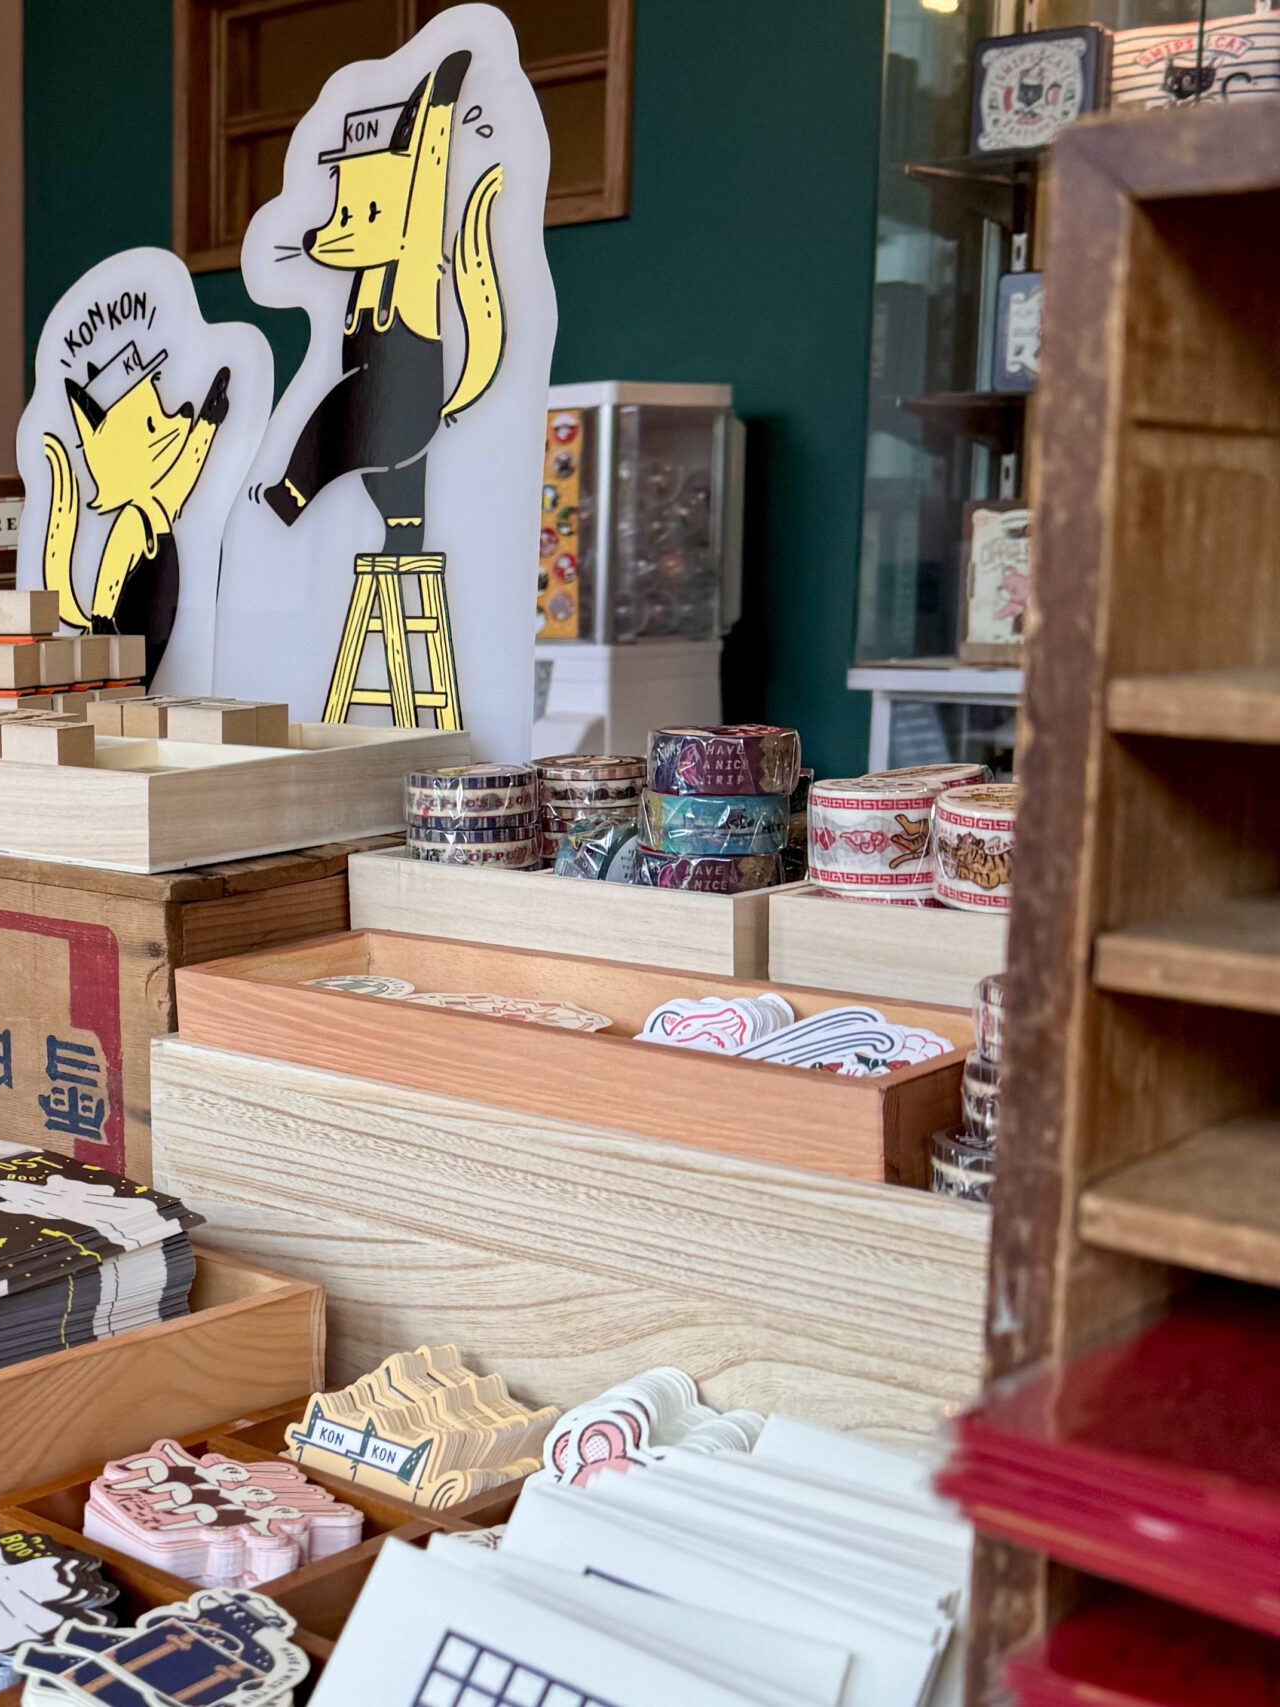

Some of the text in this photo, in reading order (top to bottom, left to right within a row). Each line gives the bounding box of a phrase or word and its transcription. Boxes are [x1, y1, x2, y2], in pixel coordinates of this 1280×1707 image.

[1214, 35, 1248, 54] CAT
[346, 120, 379, 143] KON
[706, 743, 746, 756] HAVE
[702, 760, 711, 770] A
[705, 774, 744, 786] TRIP
[693, 880, 729, 891] NICE
[320, 1426, 397, 1464] KON KON
